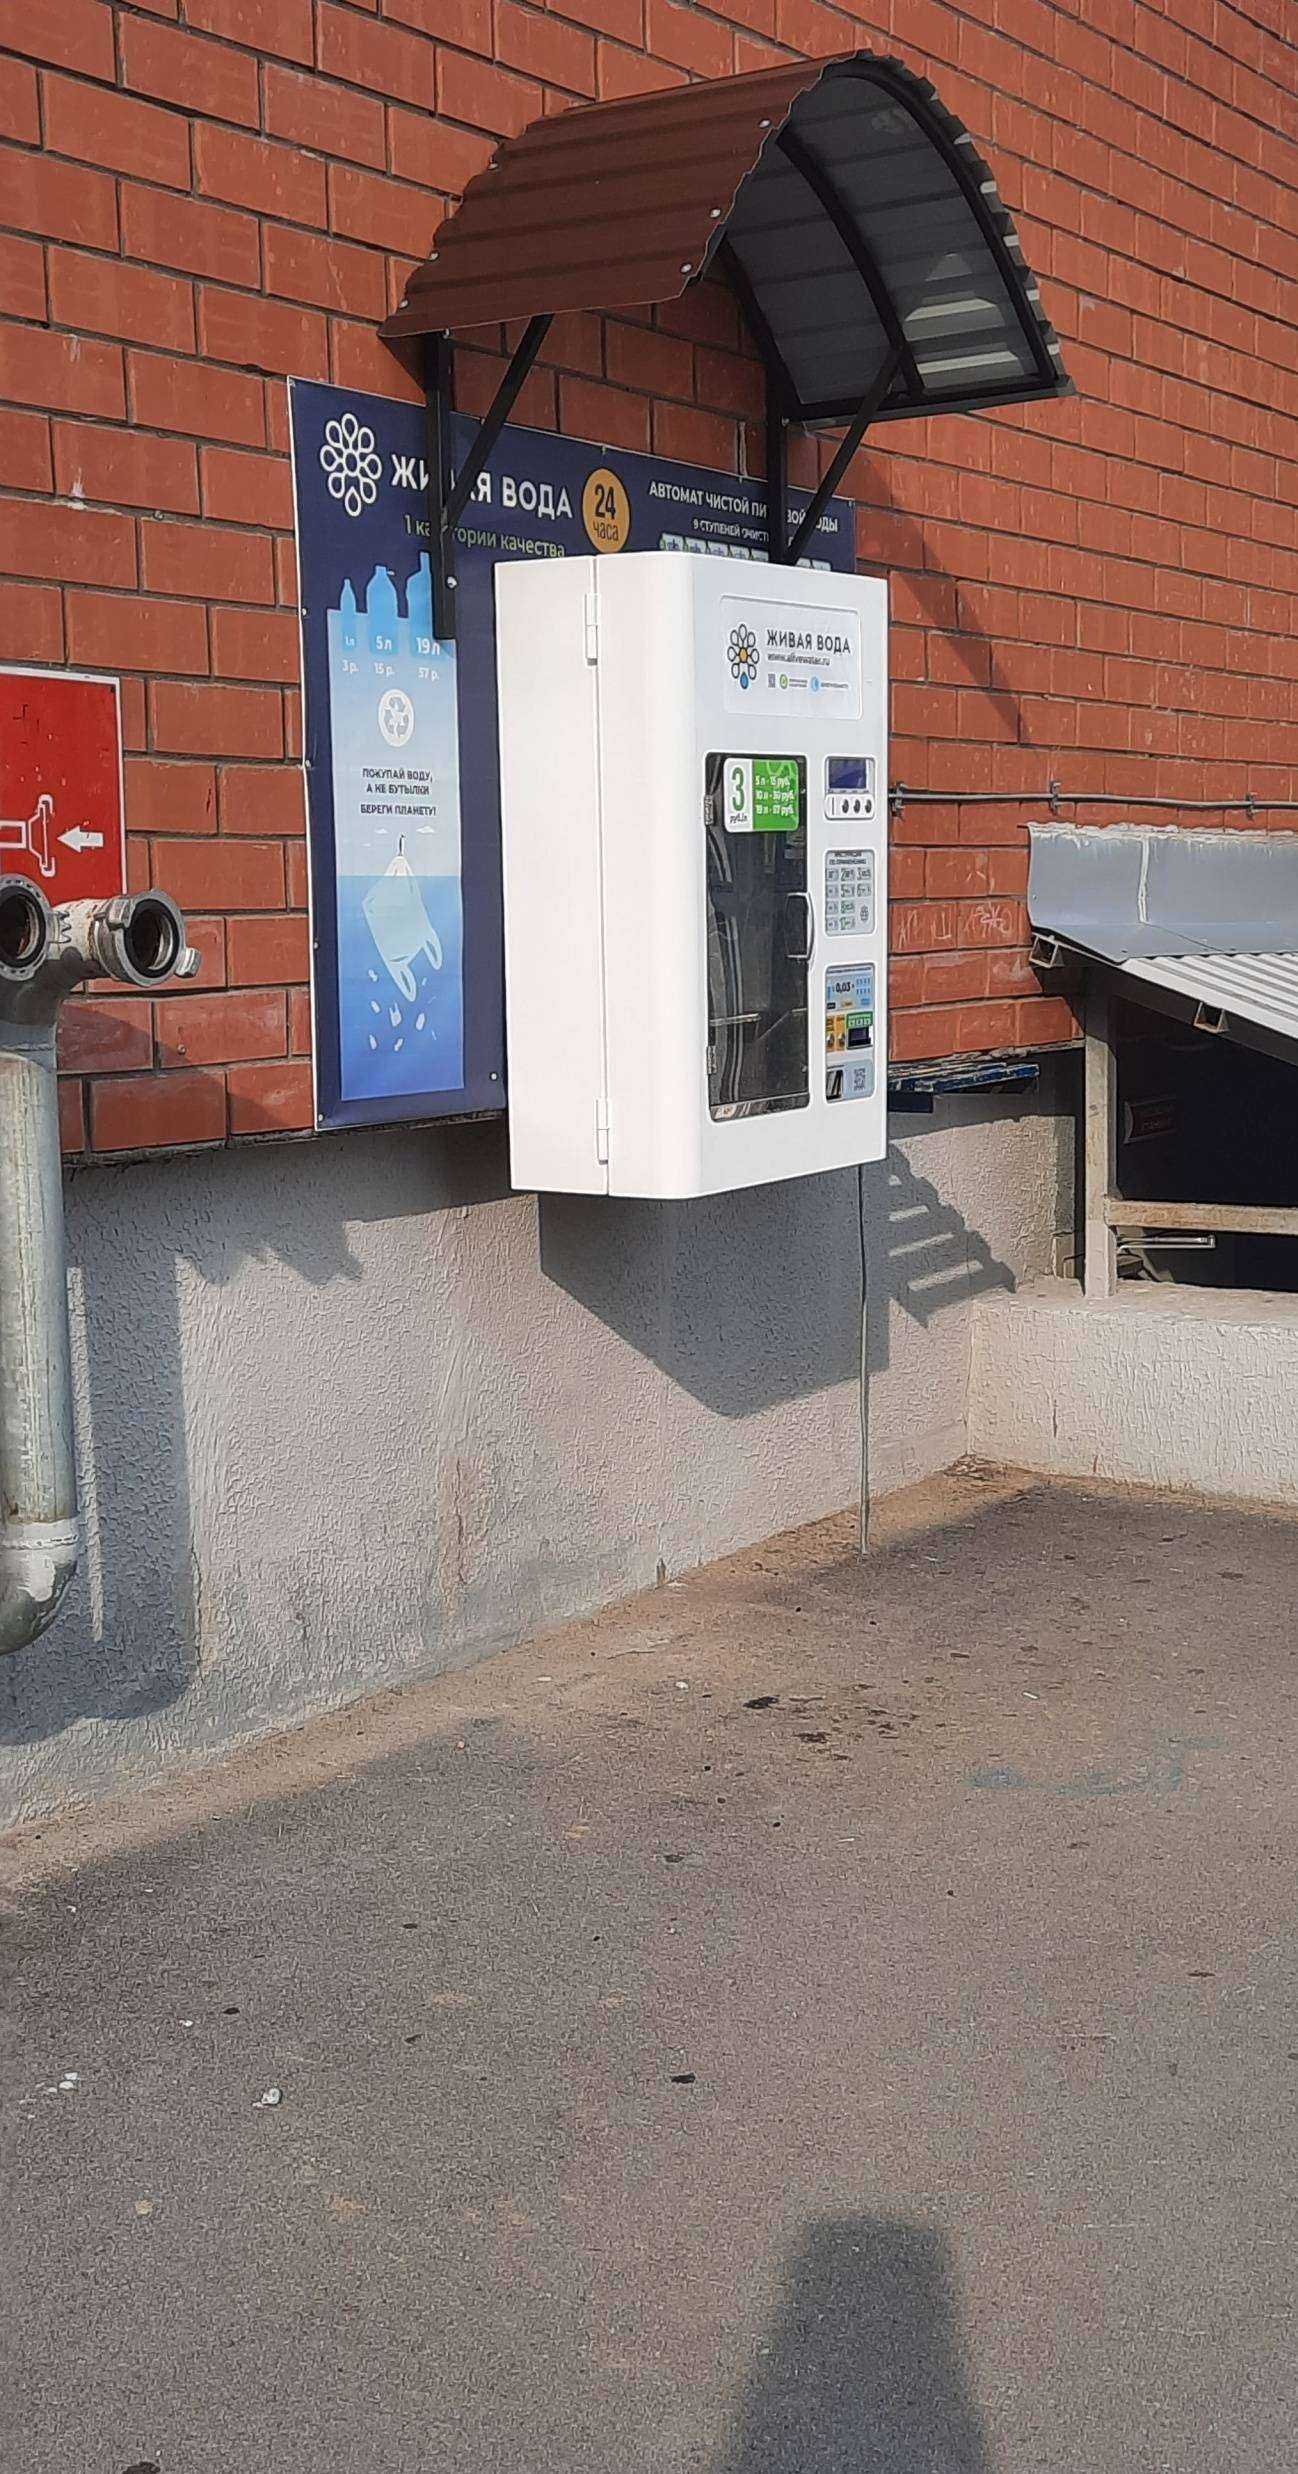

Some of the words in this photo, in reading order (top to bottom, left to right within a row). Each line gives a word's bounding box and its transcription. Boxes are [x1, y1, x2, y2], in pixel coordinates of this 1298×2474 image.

[391, 454, 492, 504] ЖИЯ
[502, 476, 573, 520] ВОДА
[649, 481, 703, 506] АВТОМАТ
[705, 492, 750, 517] ЧИСТОЙ
[594, 484, 617, 520] 24
[404, 514, 412, 535] 1
[501, 532, 565, 558] качества
[592, 520, 620, 542] часа
[700, 520, 741, 537] СТУПЕНЕЙ
[766, 628, 812, 651] ЖИВАЯ
[817, 634, 851, 654] ВОДА
[362, 767, 406, 780] ПОКУПАЙ
[407, 771, 433, 783] ВОДУ,
[366, 783, 373, 793] А
[375, 783, 387, 794] НЕ
[389, 784, 430, 795] БУТЫЛКИ
[732, 767, 745, 811] 3
[360, 803, 393, 815] БЕРЕГИ
[394, 804, 437, 816] ПЛАНЕТУ!
